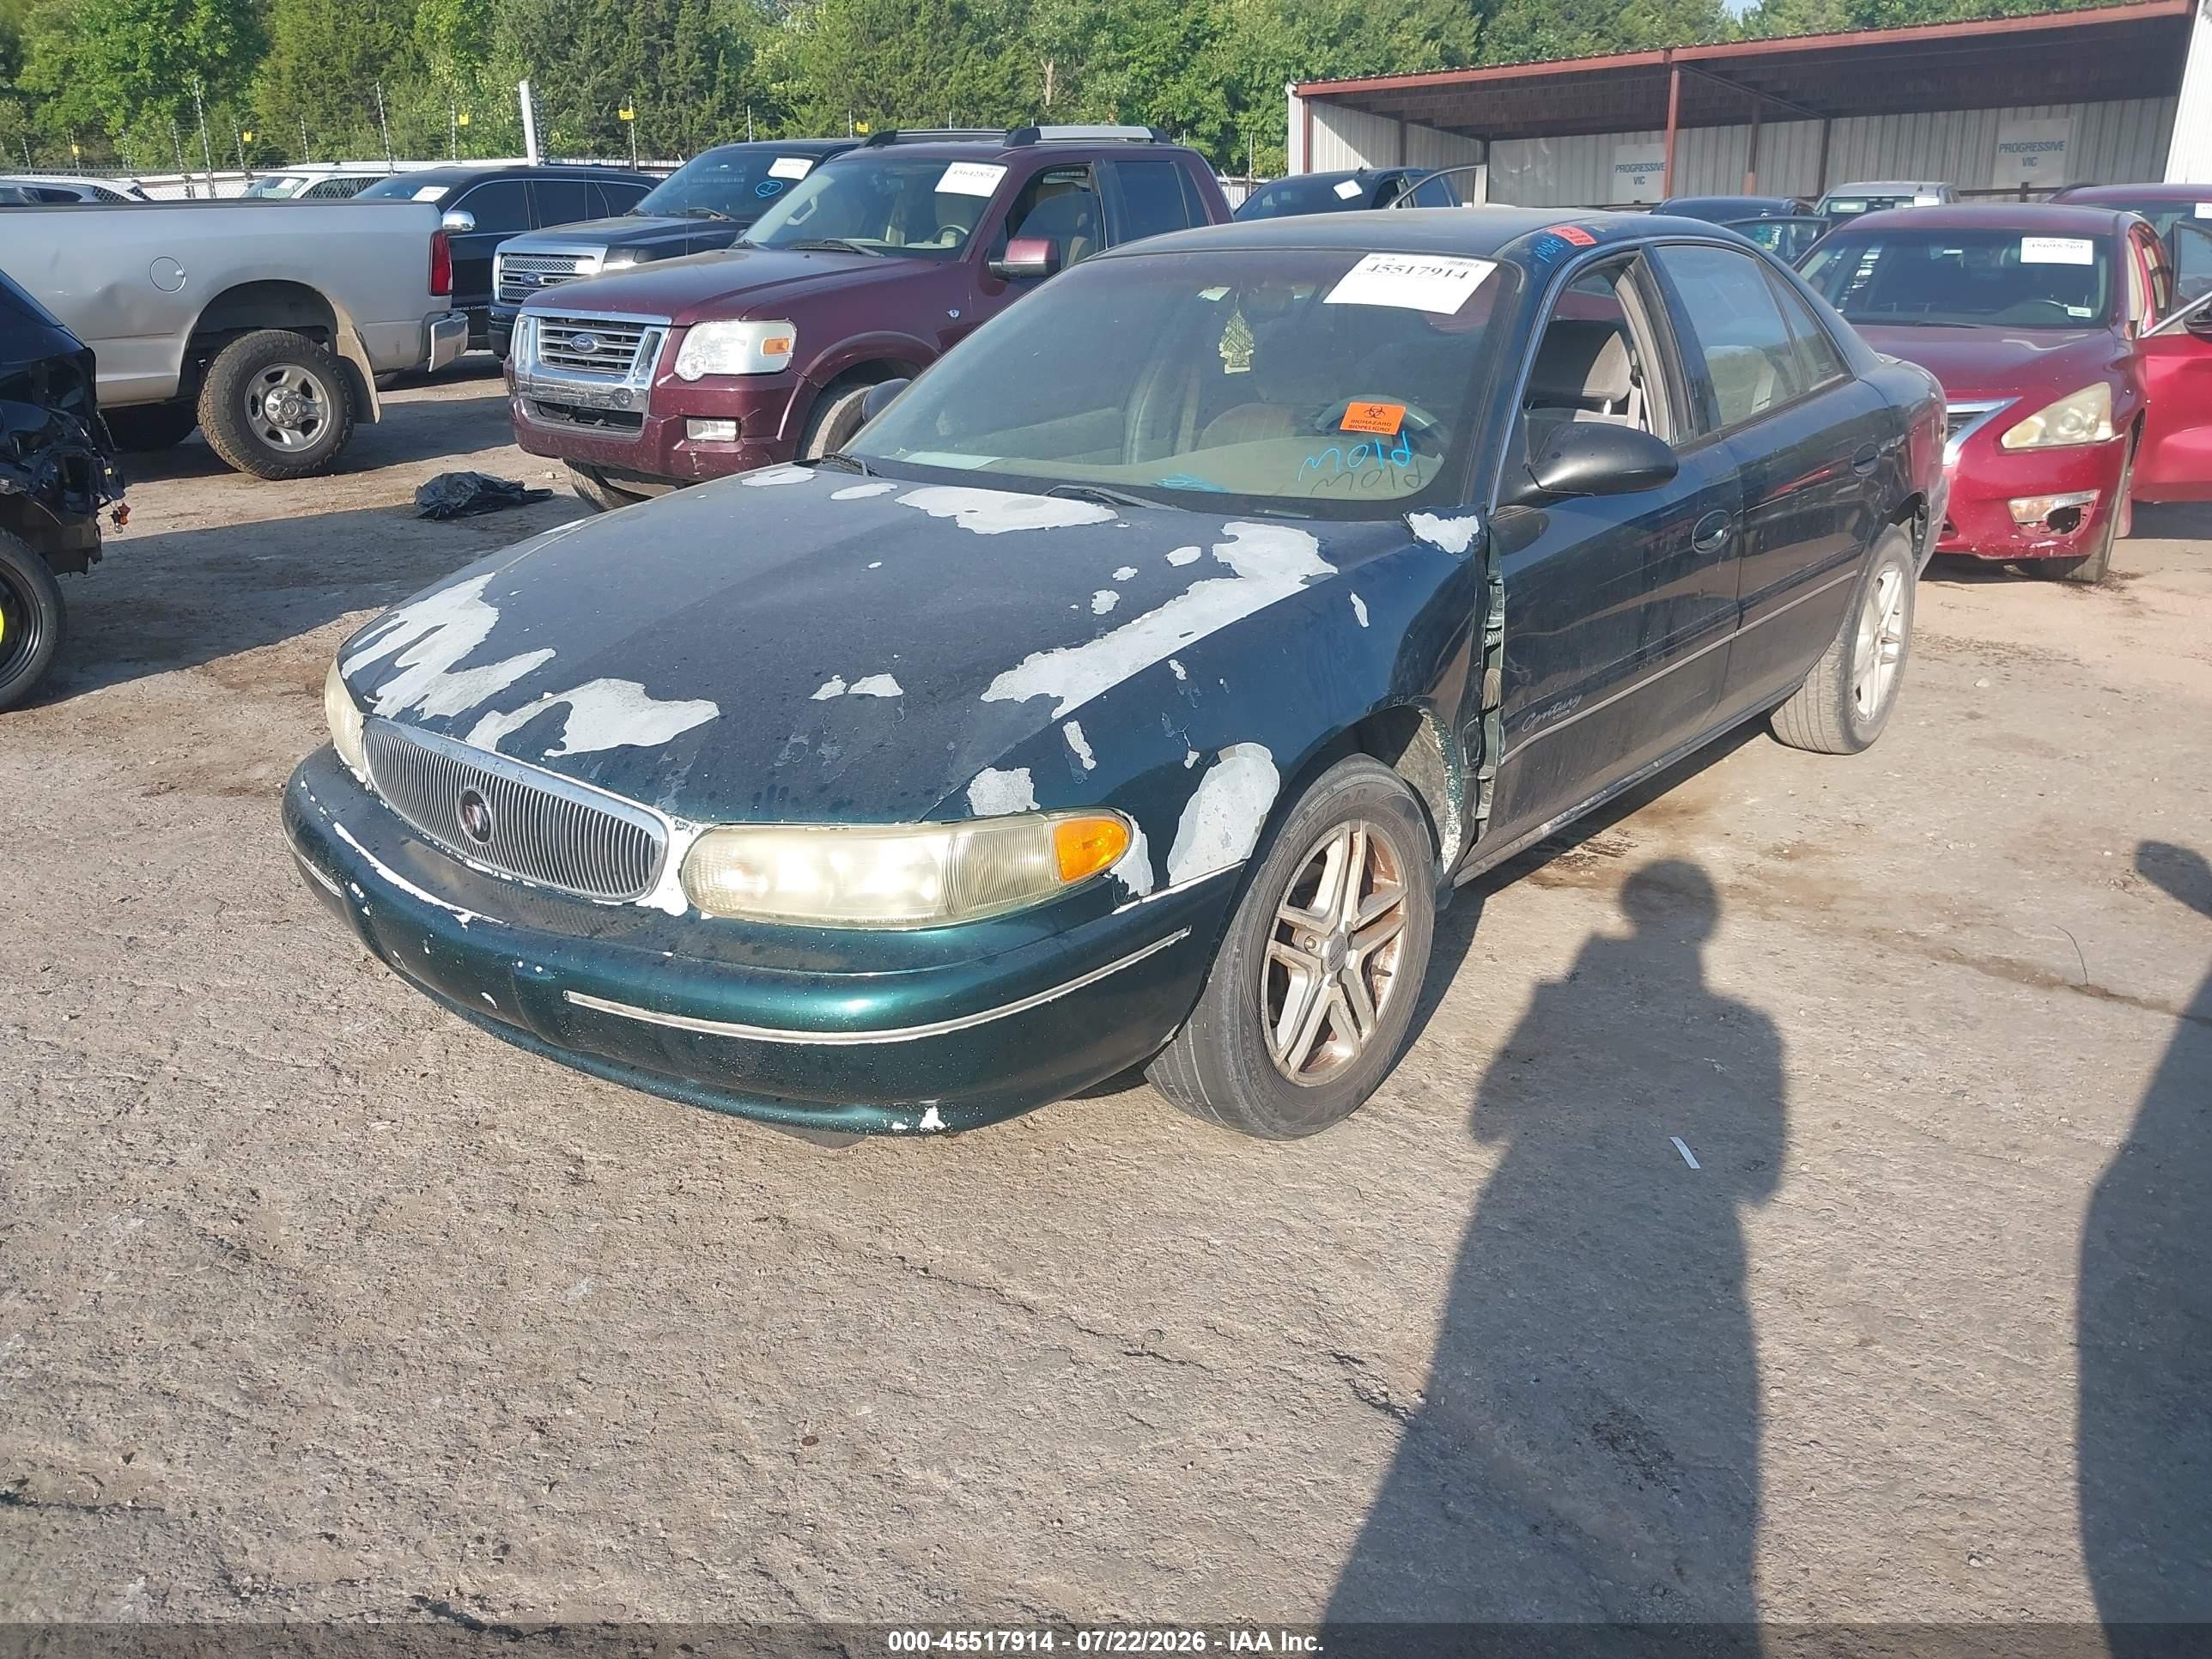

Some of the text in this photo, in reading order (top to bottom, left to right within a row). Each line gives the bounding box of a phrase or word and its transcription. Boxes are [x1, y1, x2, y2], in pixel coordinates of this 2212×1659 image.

[1998, 140, 2065, 153] PROGRESSIVE
[1614, 161, 1666, 173] PROGRESSIVE
[2021, 156, 2039, 167] VIC
[1633, 175, 1646, 185] VIC
[1365, 264, 1469, 280] 45517914
[1348, 424, 1390, 433] BIOPELIGRO
[1521, 694, 1582, 732] Century
